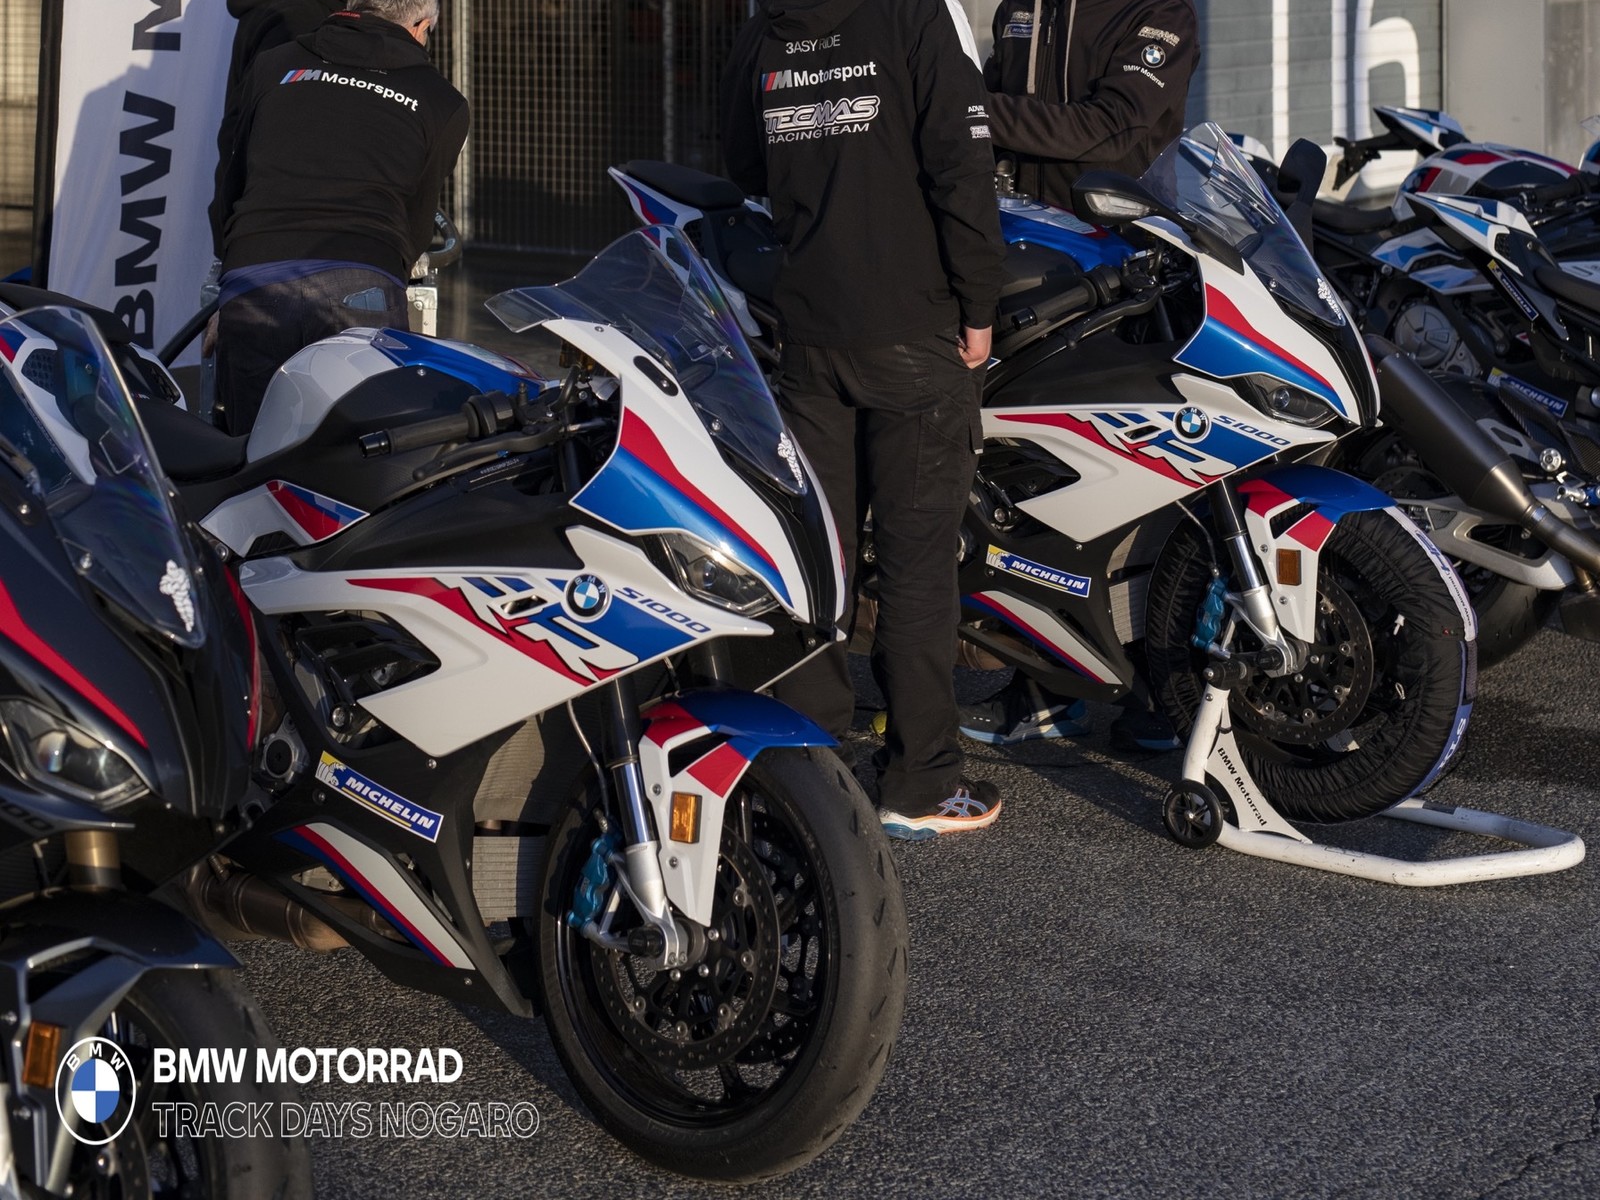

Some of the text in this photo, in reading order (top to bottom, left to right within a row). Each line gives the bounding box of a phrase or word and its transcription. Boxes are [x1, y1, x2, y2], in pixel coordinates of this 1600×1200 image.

[785, 34, 841, 54] 3ASY RIDE
[321, 71, 419, 111] Motorsport
[793, 61, 877, 88] Motorsport
[768, 122, 870, 145] RACING TEAM
[105, 90, 176, 349] BMW
[1011, 560, 1086, 590] MICHELIN
[345, 776, 436, 829] MICHELIN
[1217, 747, 1268, 827] BMW Motorrad
